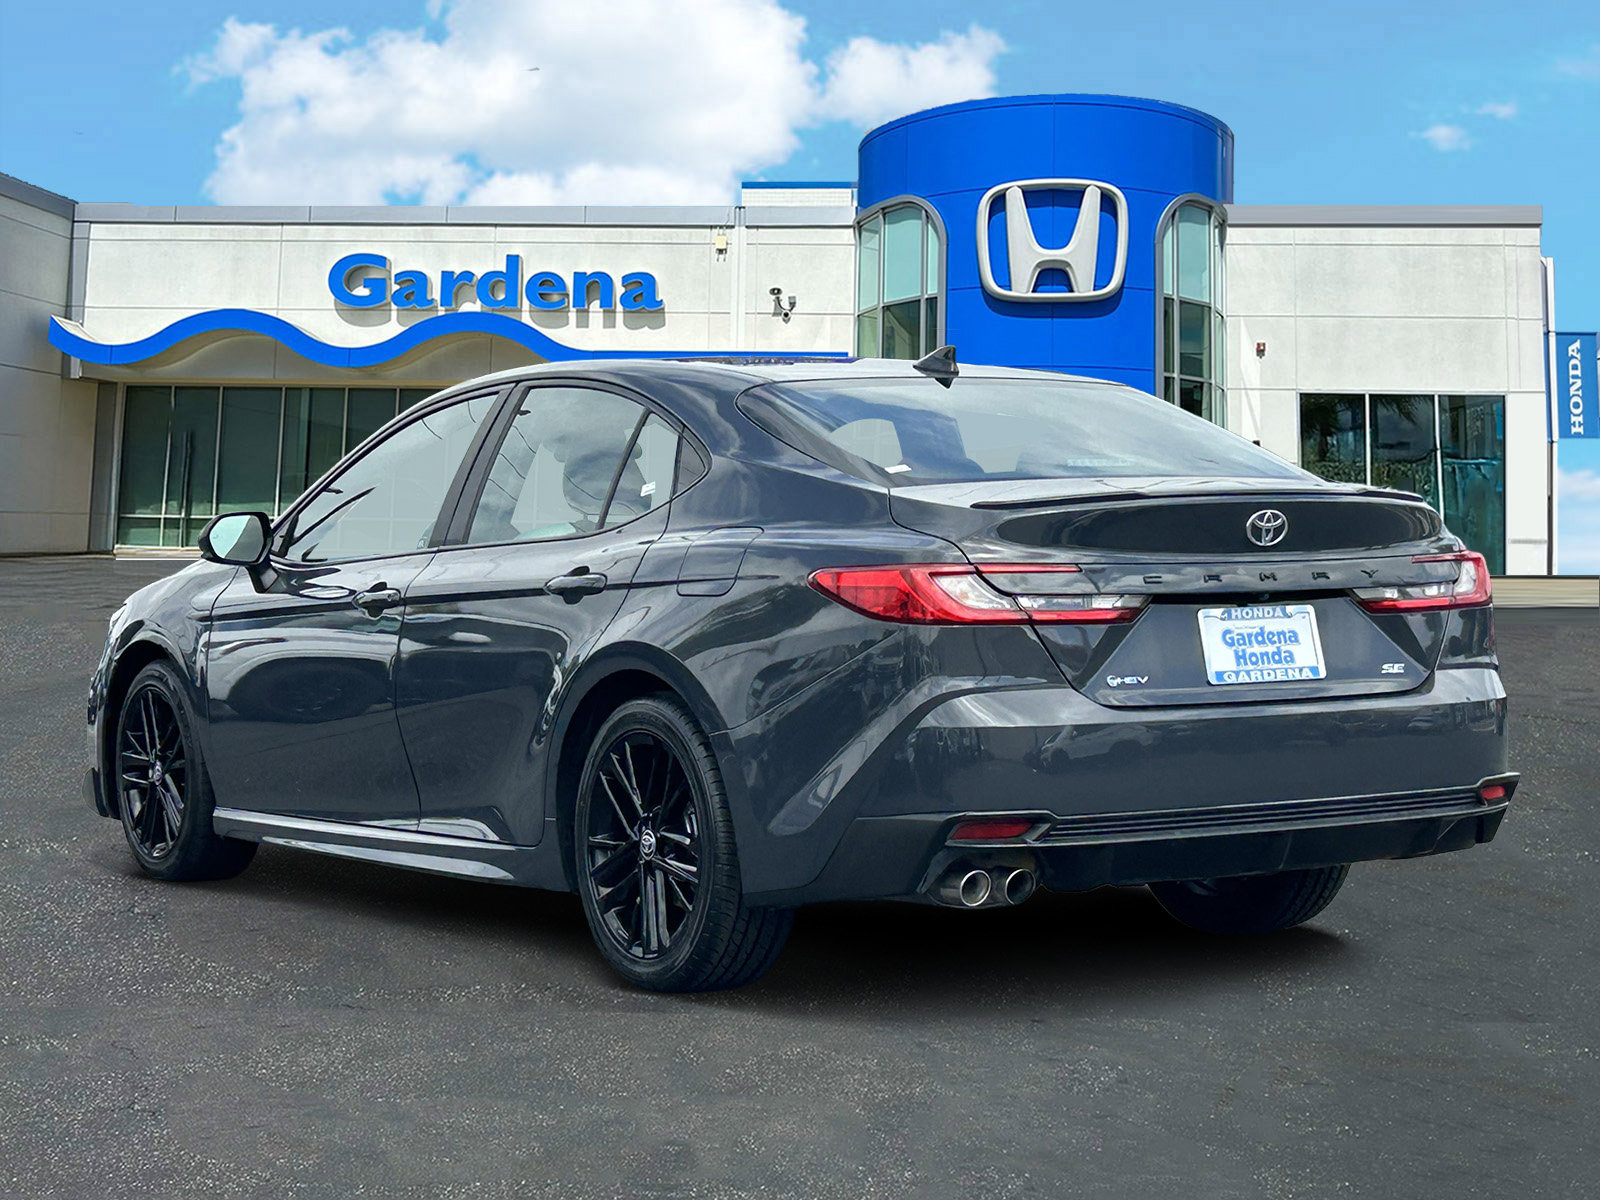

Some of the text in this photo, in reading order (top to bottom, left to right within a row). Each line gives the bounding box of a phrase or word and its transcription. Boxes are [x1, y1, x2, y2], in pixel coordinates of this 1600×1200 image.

[328, 253, 664, 310] Gardena
[1568, 339, 1584, 435] HONDA
[1231, 606, 1284, 620] HONDA
[1222, 627, 1299, 647] Gardena
[1234, 646, 1294, 667] Honda
[1223, 668, 1313, 683] GARDENA
[1381, 663, 1405, 674] SE
